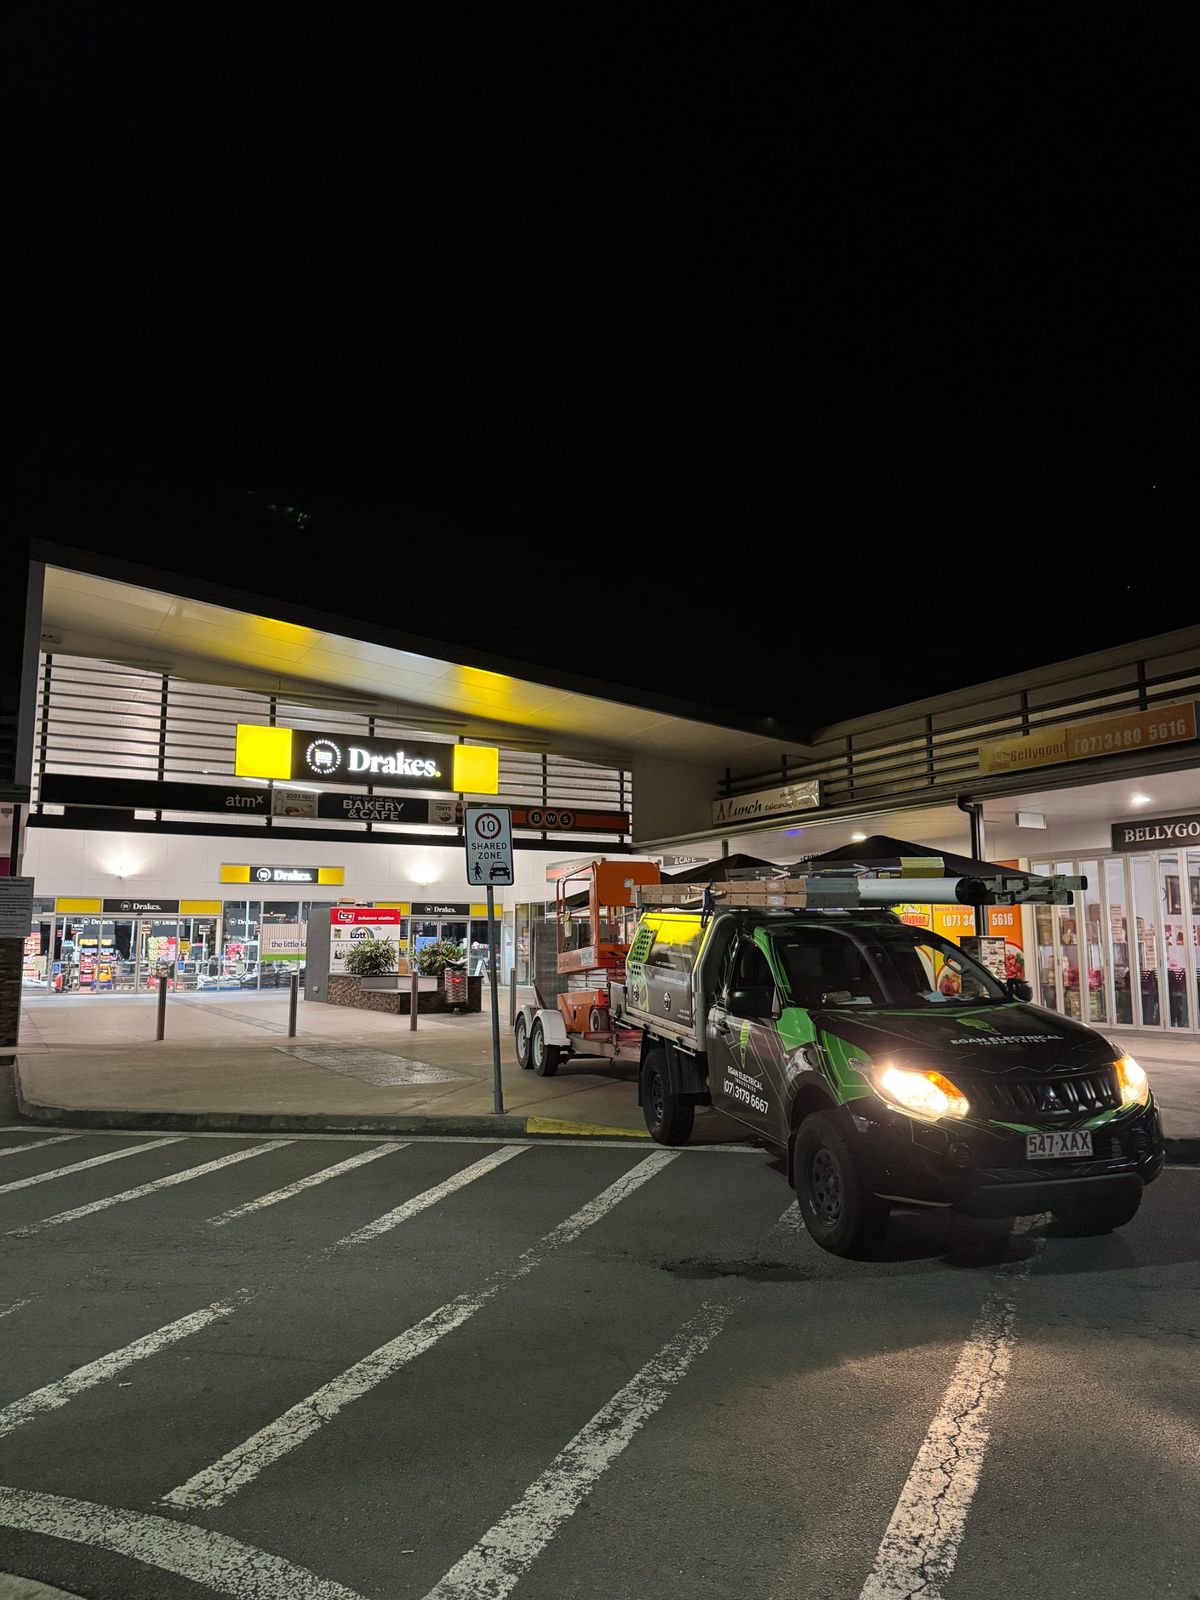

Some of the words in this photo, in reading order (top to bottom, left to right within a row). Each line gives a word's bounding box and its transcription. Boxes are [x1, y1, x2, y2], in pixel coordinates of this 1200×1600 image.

[1149, 718, 1187, 740] 5616
[347, 748, 442, 777] Drakes.
[343, 800, 405, 811] BAKERY
[718, 800, 762, 820] Munch
[482, 819, 496, 832] 10
[1124, 821, 1200, 843] BELLYGO
[471, 841, 507, 851] SHARED
[477, 851, 502, 860] ZONE
[991, 912, 1014, 926] 5616
[988, 1034, 1065, 1043] ELECTRICAL
[723, 1077, 735, 1098] (07)
[750, 1094, 769, 1114] 6667
